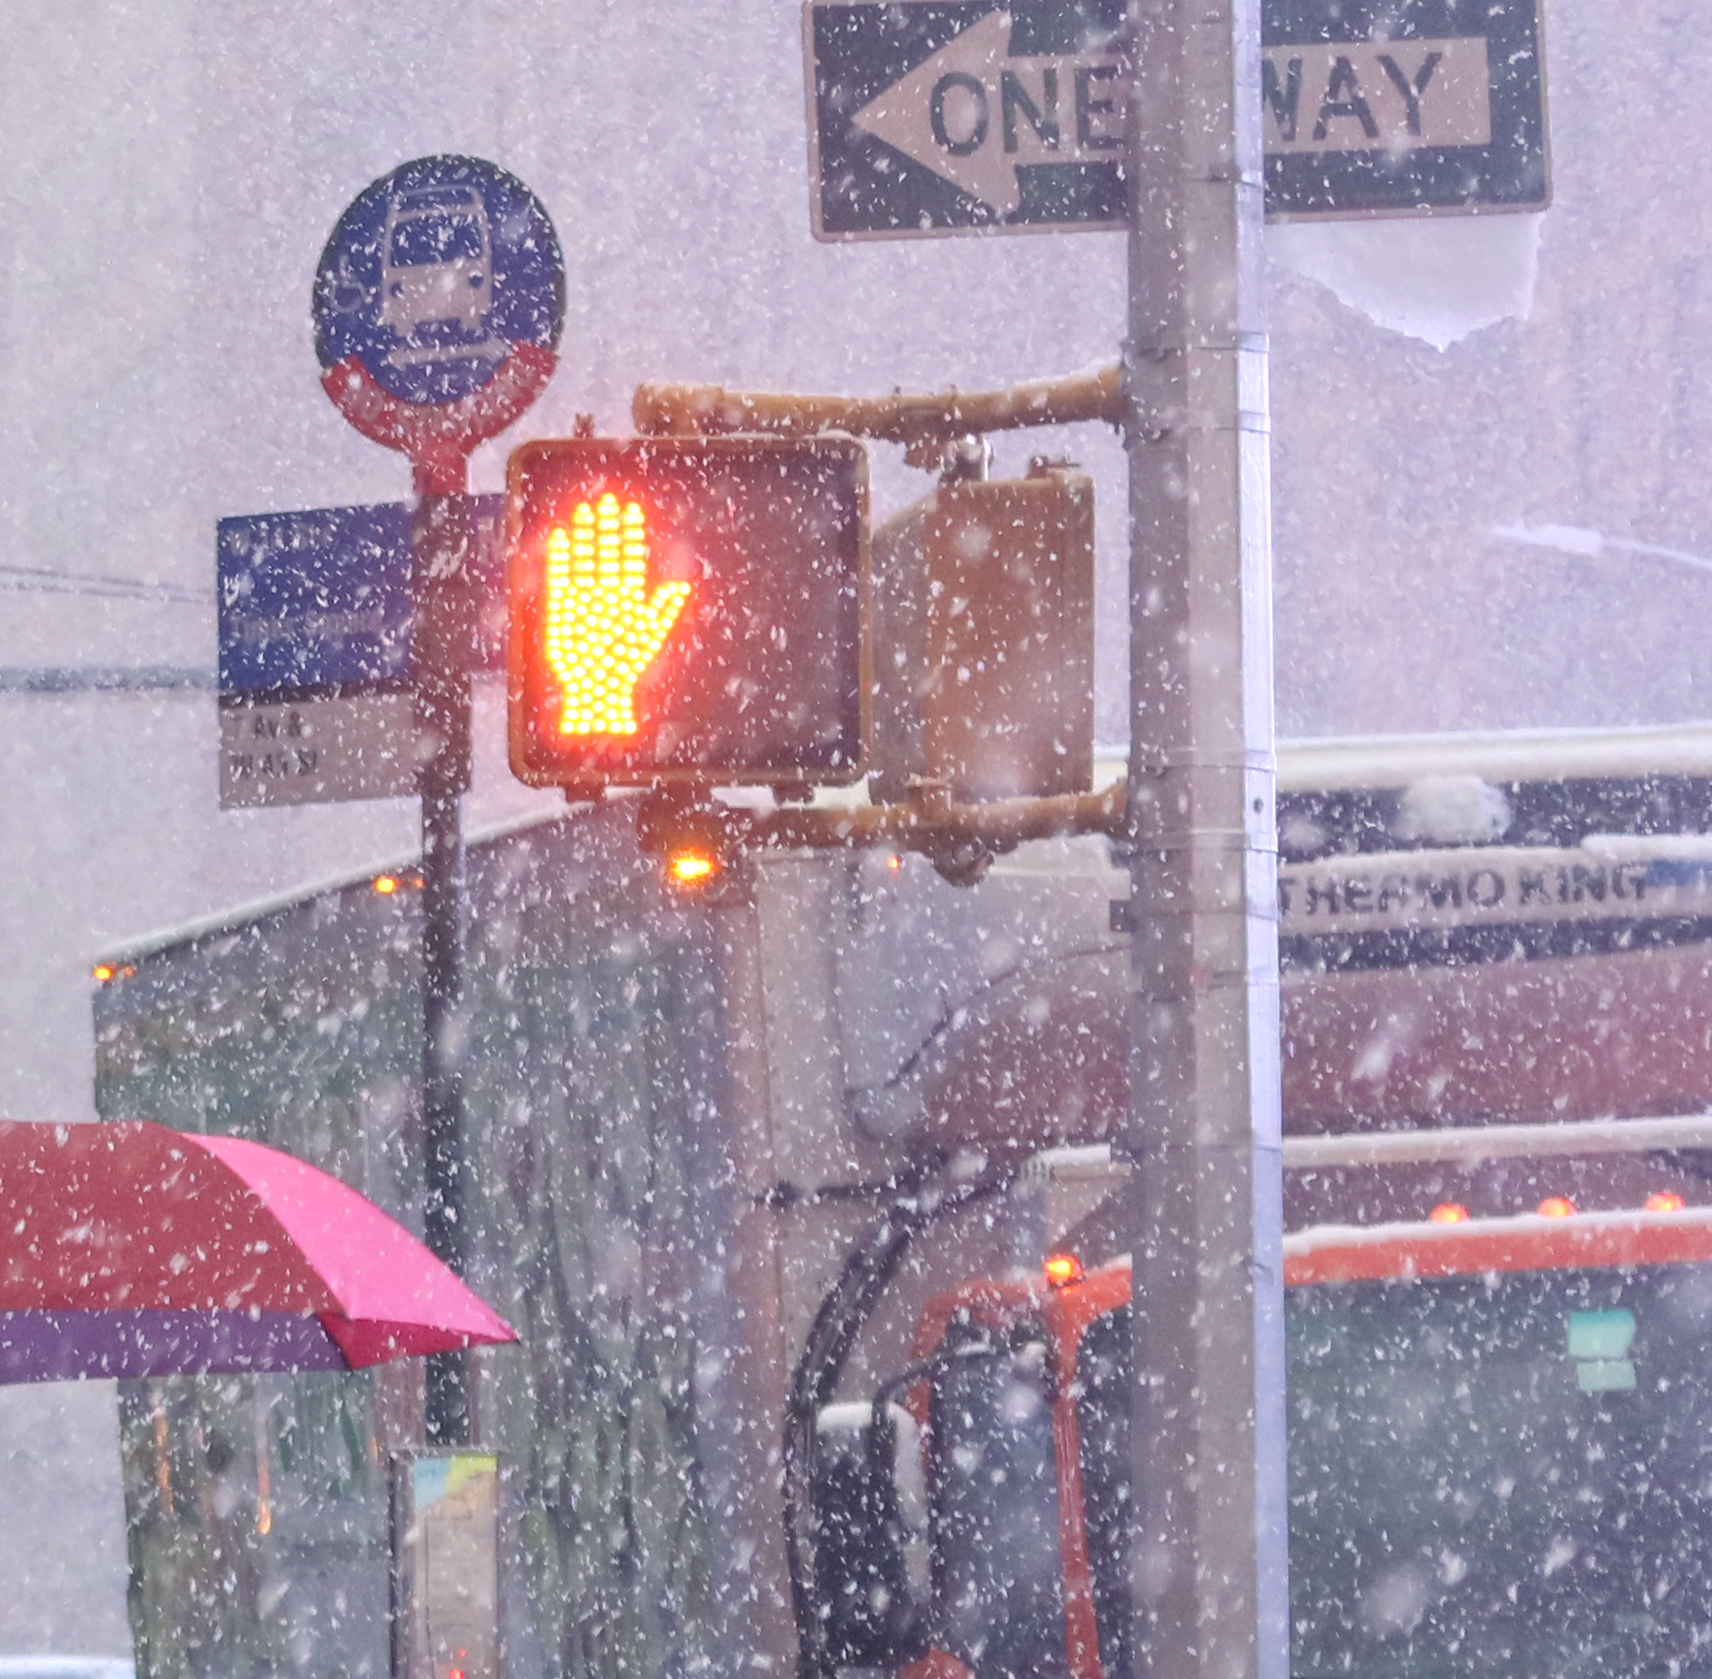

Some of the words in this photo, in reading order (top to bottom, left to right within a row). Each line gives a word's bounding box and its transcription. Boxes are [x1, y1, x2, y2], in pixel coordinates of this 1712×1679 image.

[929, 63, 1126, 156] ONE
[1277, 868, 1506, 916] THERMO
[1518, 860, 1647, 905] KING
